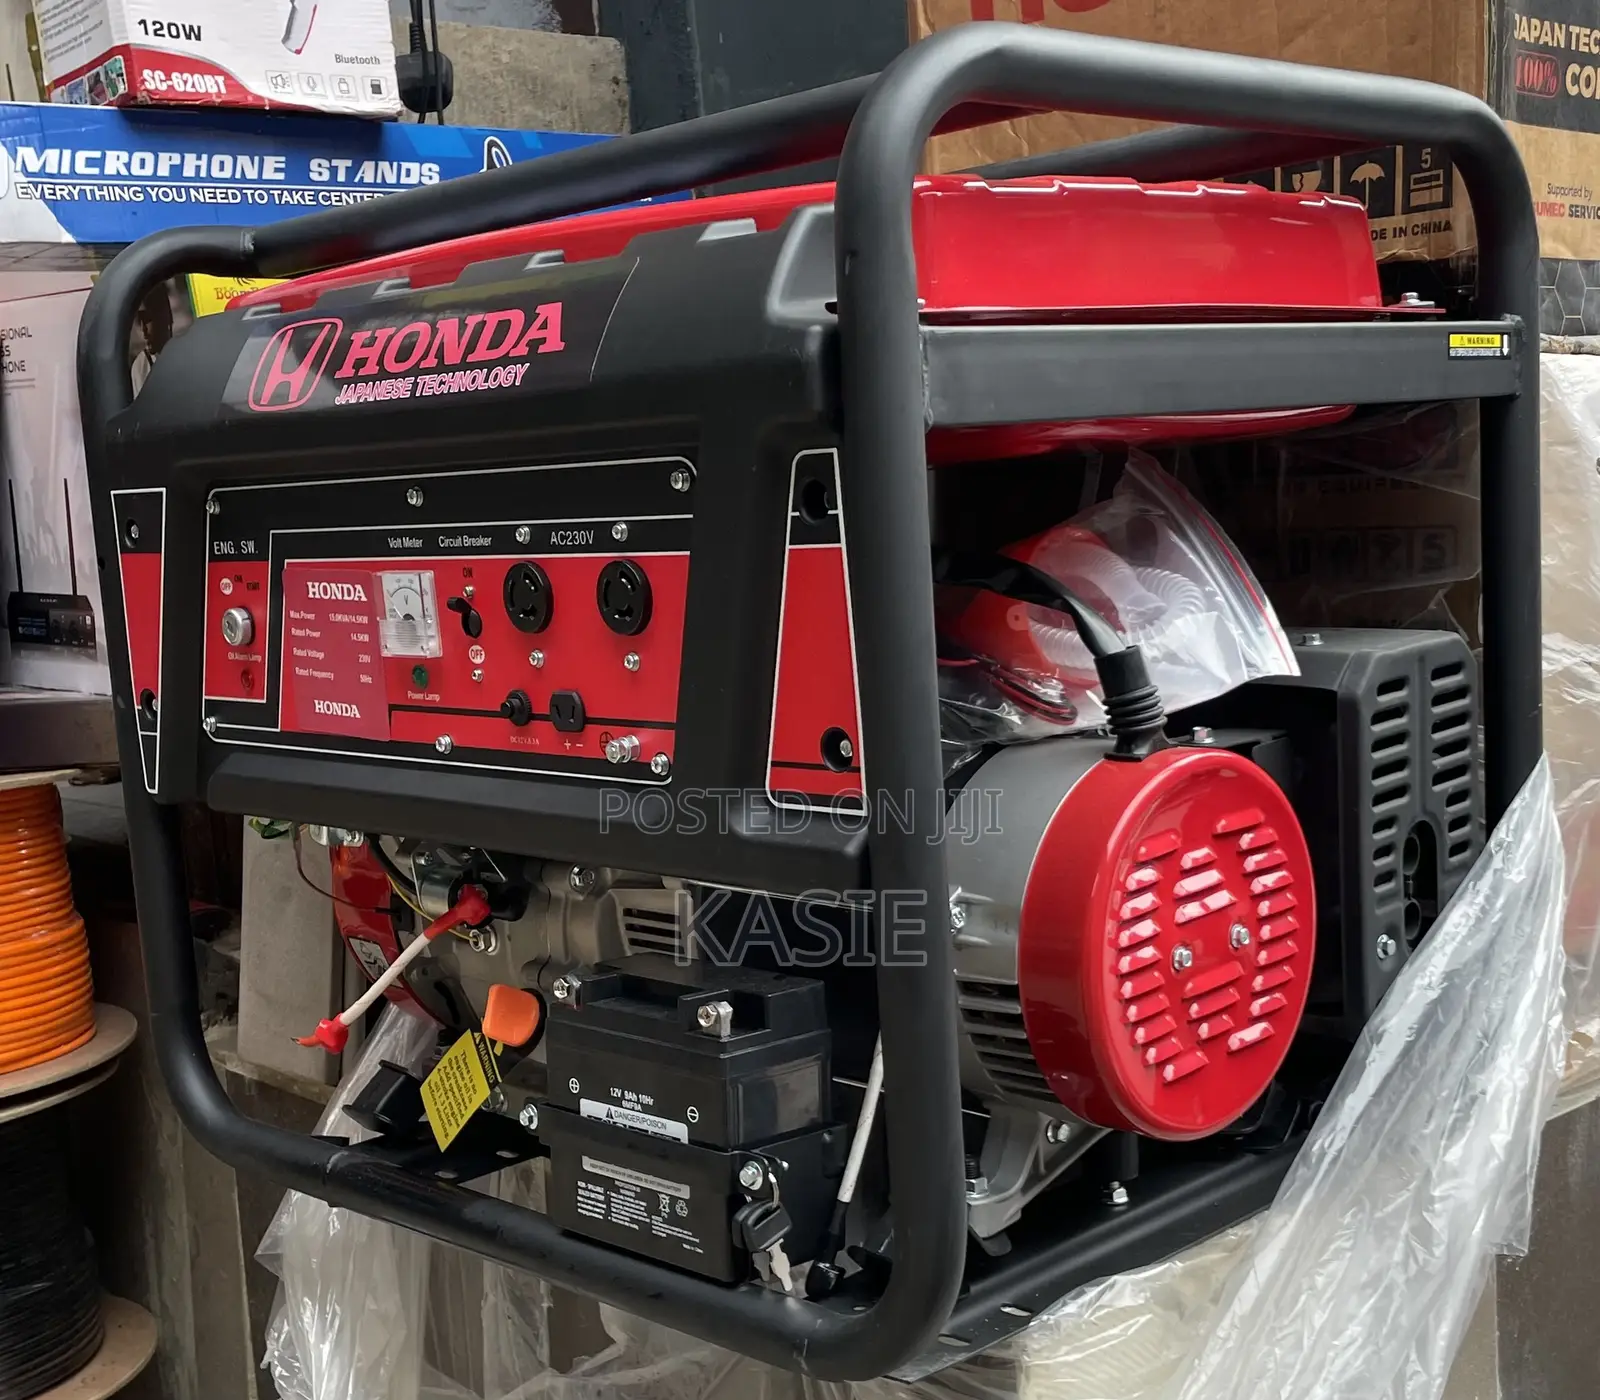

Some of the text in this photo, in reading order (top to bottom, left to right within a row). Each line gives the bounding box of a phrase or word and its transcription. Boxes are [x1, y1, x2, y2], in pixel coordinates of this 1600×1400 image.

[138, 18, 202, 42] 120W
[1514, 13, 1566, 49] JAPAN
[334, 52, 381, 66] Bluetooth
[141, 68, 227, 95] SC-620BT
[1515, 55, 1558, 94] 100%
[14, 146, 441, 186] MICROPHONE STANDS
[1421, 147, 1431, 169] 5
[15, 181, 145, 203] EVERYTHING
[145, 186, 191, 204] YOU
[189, 187, 243, 205] NEED
[242, 189, 270, 206] TO
[269, 191, 317, 207] TAKE
[1547, 182, 1593, 202] Supported by
[1535, 200, 1565, 218] UMEC
[1392, 225, 1408, 239] IN
[1411, 219, 1453, 236] CHINA
[334, 302, 565, 378] HONDA
[1467, 337, 1495, 345] WARNING
[334, 361, 531, 405] JAPANESE TECHNOLOGY
[213, 540, 259, 555] ENG. SW.
[388, 537, 424, 549] Volt Meter
[438, 534, 492, 548] Circuit Breaker
[550, 530, 594, 546] AC230V
[462, 567, 473, 578] ON
[221, 581, 231, 591] OFF
[307, 581, 367, 602] HONDA
[470, 649, 484, 660] OFF
[408, 690, 440, 703] Power Lamp
[314, 699, 361, 719] HONDA
[461, 1050, 471, 1075] There
[478, 1042, 495, 1083] WARNING
[610, 1087, 621, 1098] 12V
